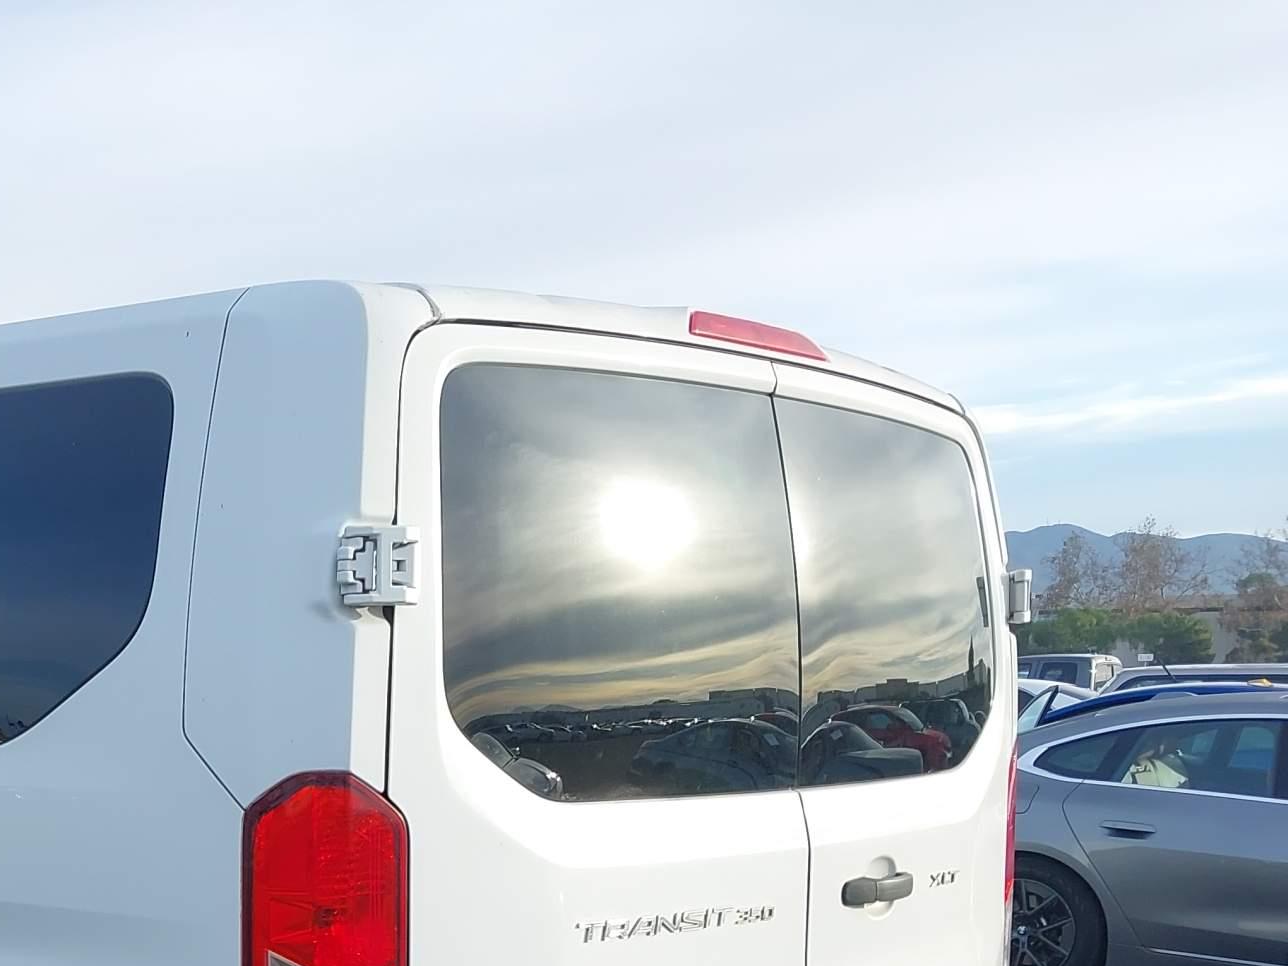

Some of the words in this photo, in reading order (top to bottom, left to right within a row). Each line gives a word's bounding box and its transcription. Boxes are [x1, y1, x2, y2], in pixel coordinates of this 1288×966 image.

[928, 869, 961, 889] XLT
[574, 905, 733, 944] TRANSIT
[734, 904, 776, 926] 350
